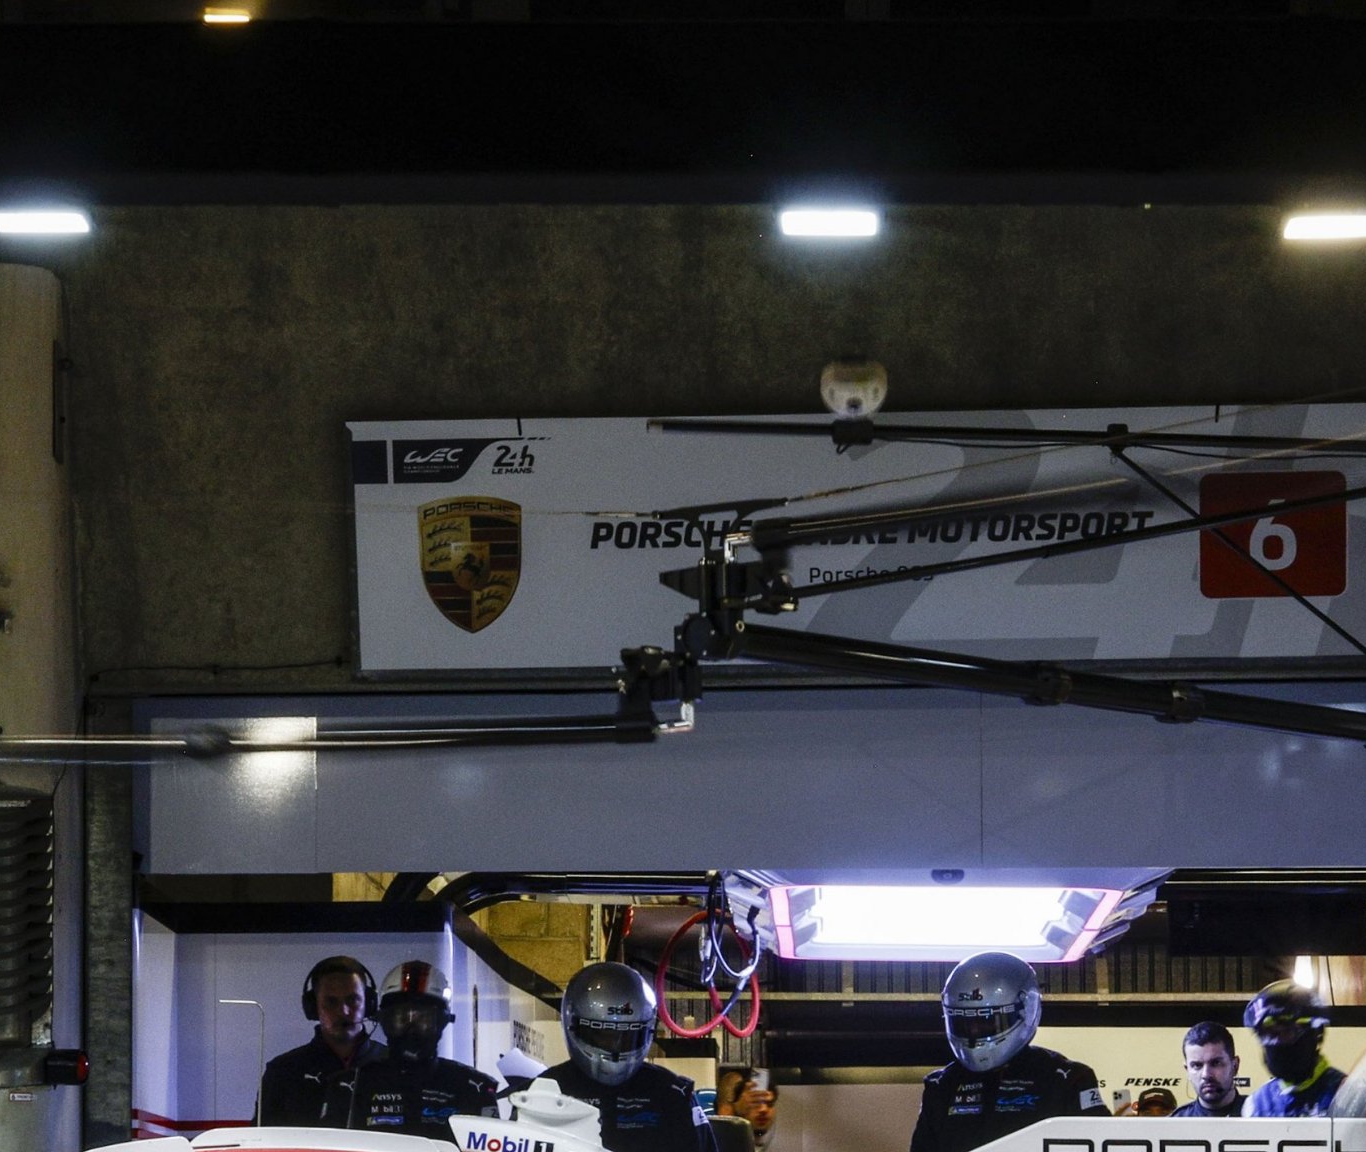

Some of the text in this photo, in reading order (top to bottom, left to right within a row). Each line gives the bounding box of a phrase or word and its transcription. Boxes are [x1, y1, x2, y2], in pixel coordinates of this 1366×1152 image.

[423, 502, 516, 520] PORSCHE
[1247, 499, 1297, 571] 6
[1124, 1078, 1181, 1087] PENSKE
[372, 1093, 403, 1101] Ansys
[371, 1105, 393, 1113] Mbil
